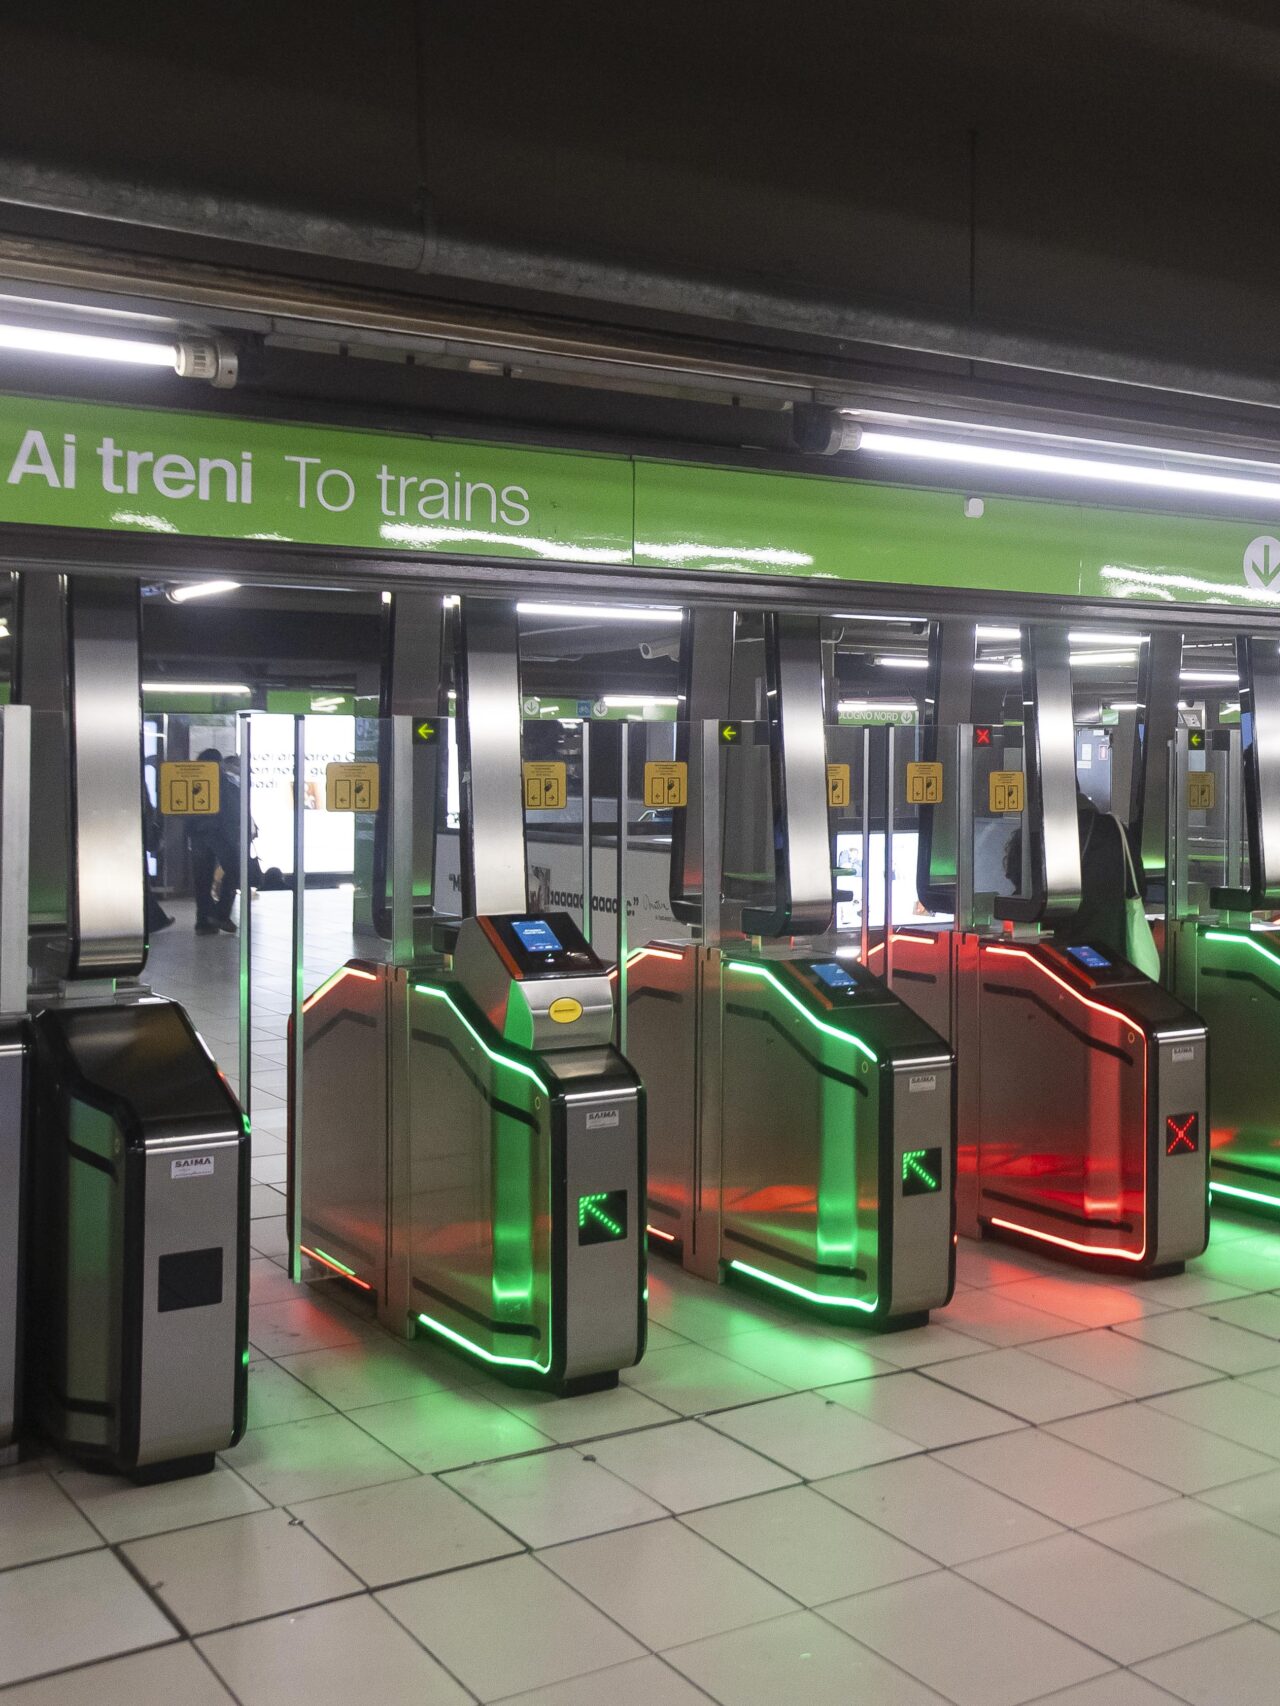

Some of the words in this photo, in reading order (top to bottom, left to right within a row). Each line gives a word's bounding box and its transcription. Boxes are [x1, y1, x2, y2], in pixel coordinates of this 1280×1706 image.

[7, 429, 76, 489] Ai
[96, 437, 252, 504] treni
[284, 455, 356, 512] To
[376, 464, 530, 526] trains
[874, 712, 899, 721] NORD
[175, 1158, 211, 1168] SAIMA
